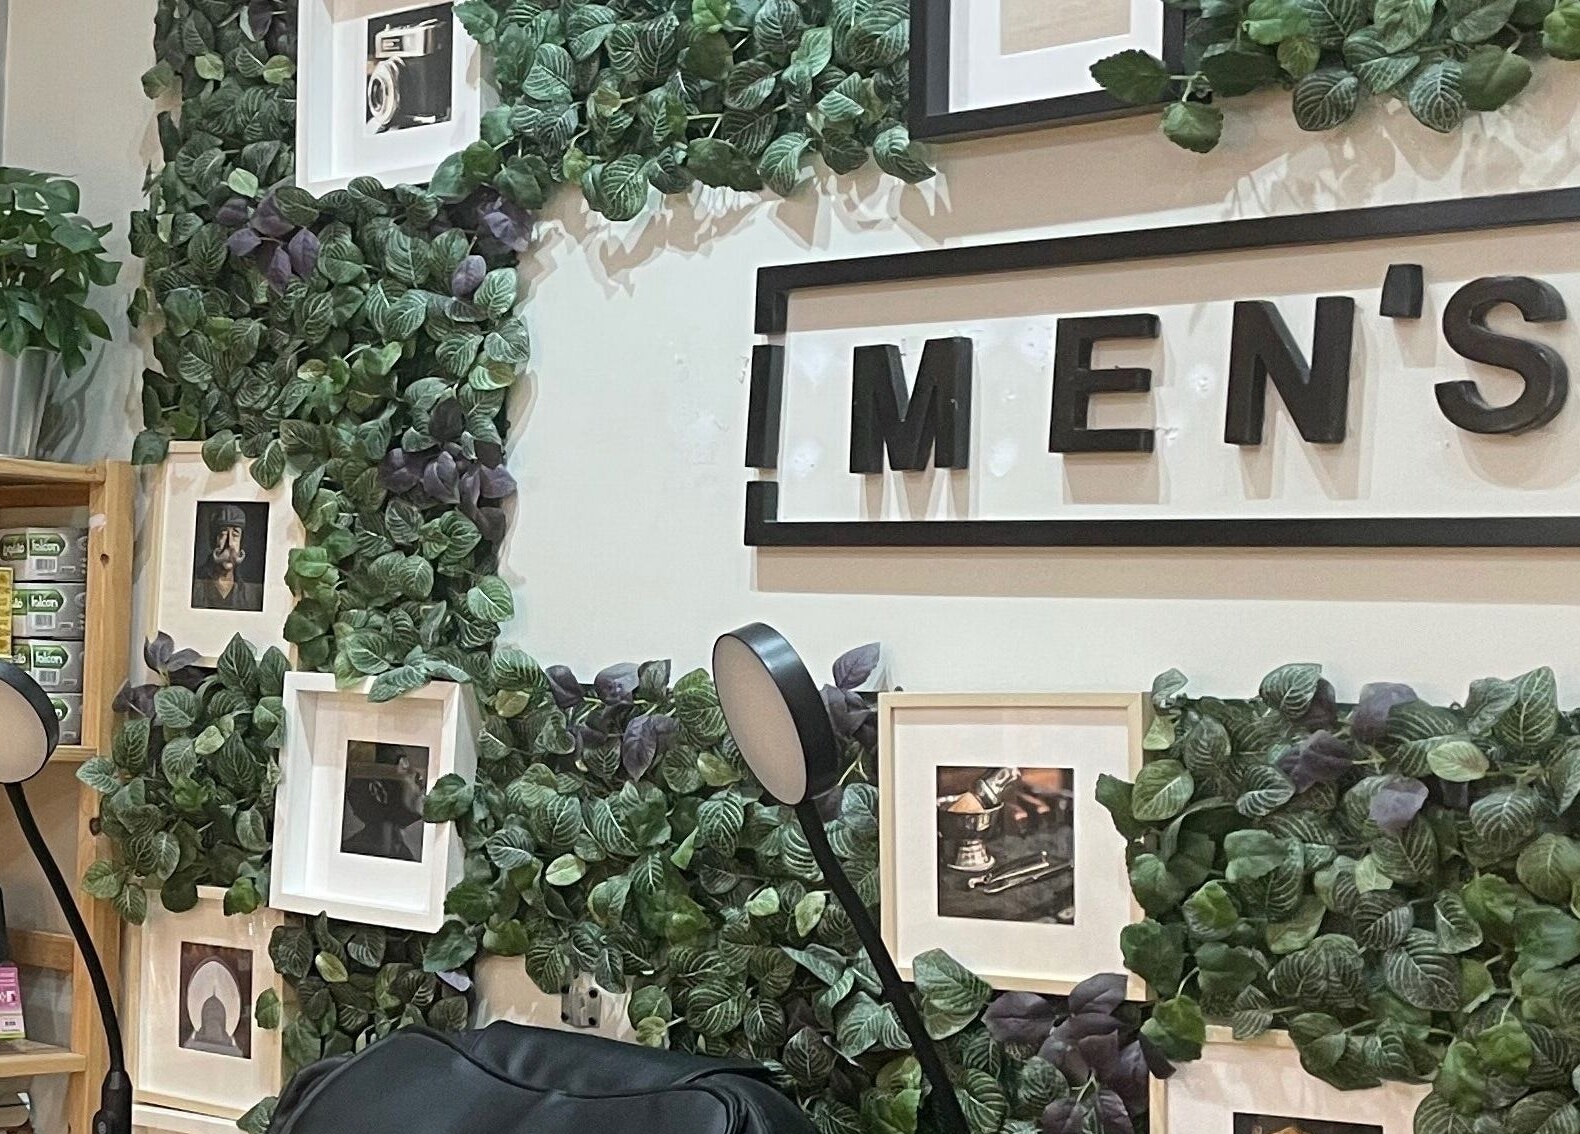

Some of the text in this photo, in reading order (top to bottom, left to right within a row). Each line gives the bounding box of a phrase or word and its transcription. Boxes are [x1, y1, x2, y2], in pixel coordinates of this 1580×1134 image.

[849, 263, 1567, 474] MEN'S
[32, 539, 60, 551] falcon
[31, 595, 58, 608] falcon
[35, 651, 63, 664] falcon
